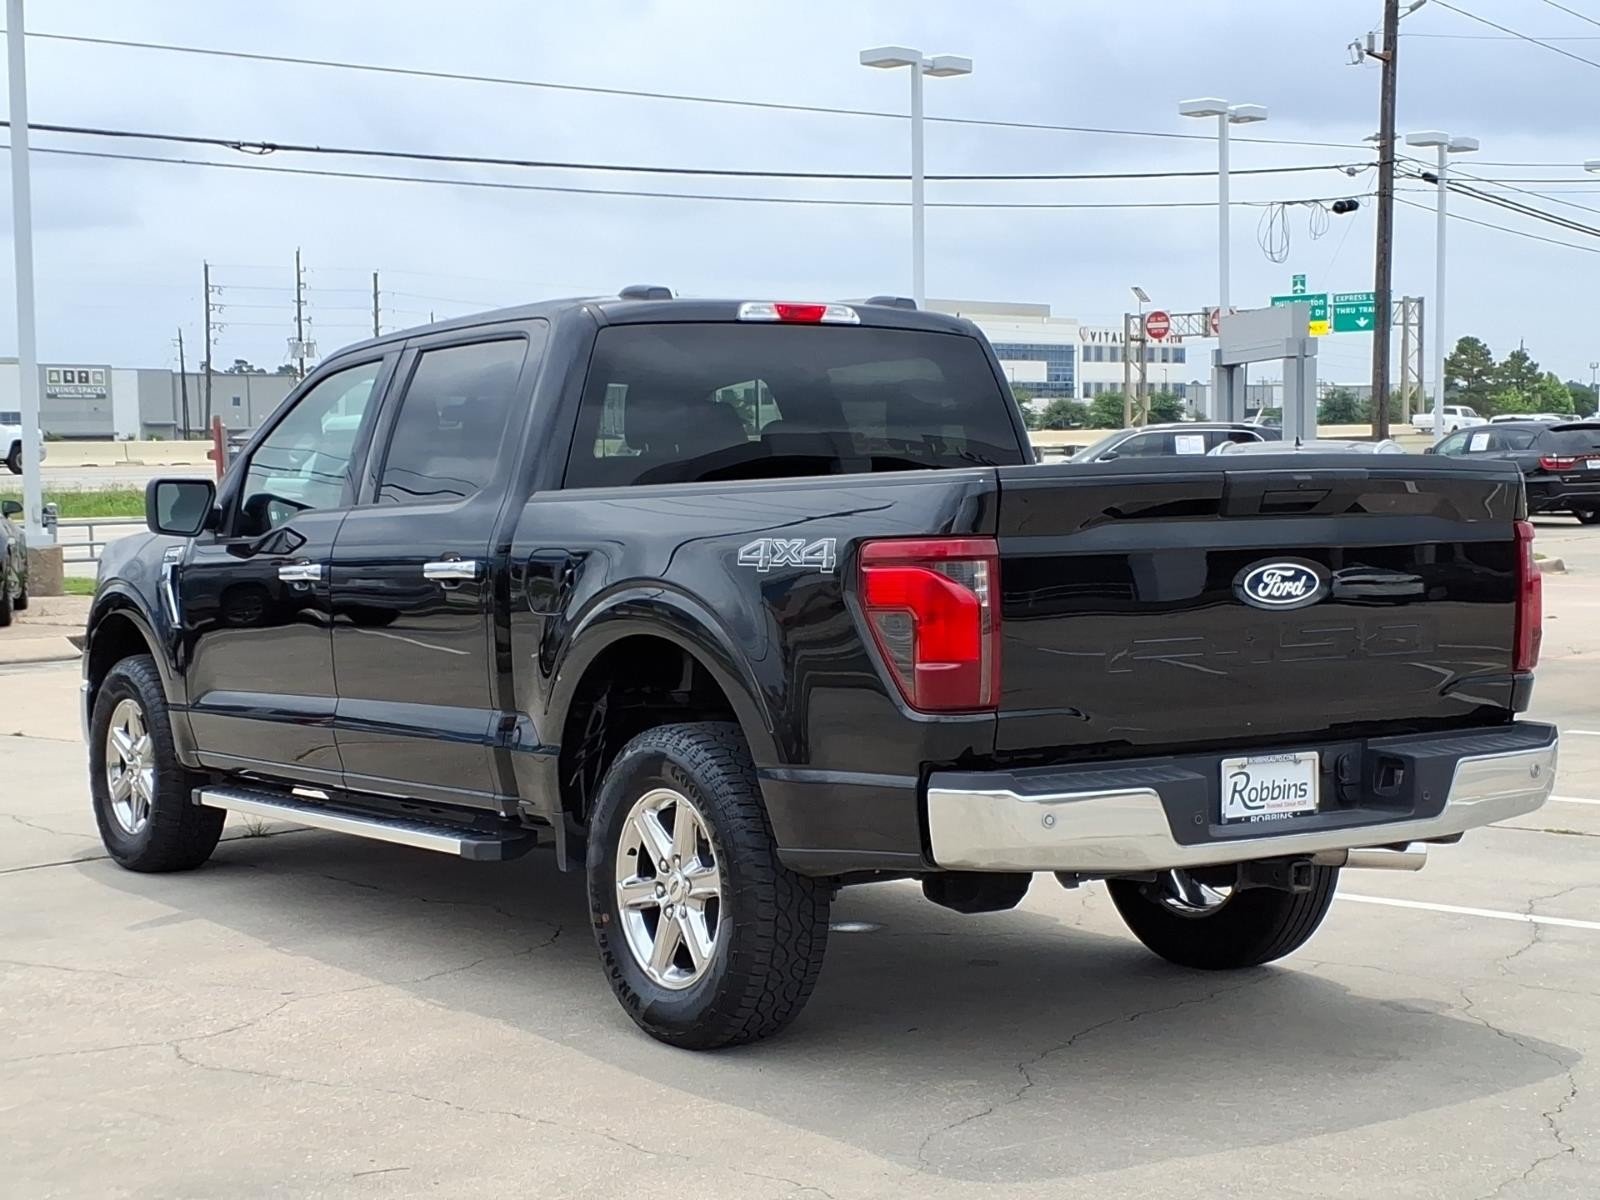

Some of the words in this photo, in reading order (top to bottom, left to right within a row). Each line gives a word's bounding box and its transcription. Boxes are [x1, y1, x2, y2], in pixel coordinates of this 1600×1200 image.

[1336, 294, 1367, 302] EXPRESS
[1090, 331, 1125, 343] VITAL
[47, 386, 75, 394] LIVING
[77, 386, 106, 394] SPACES
[1257, 569, 1307, 597] Ford
[1229, 771, 1308, 811] Robbins
[1250, 812, 1294, 823] ROBBINS
